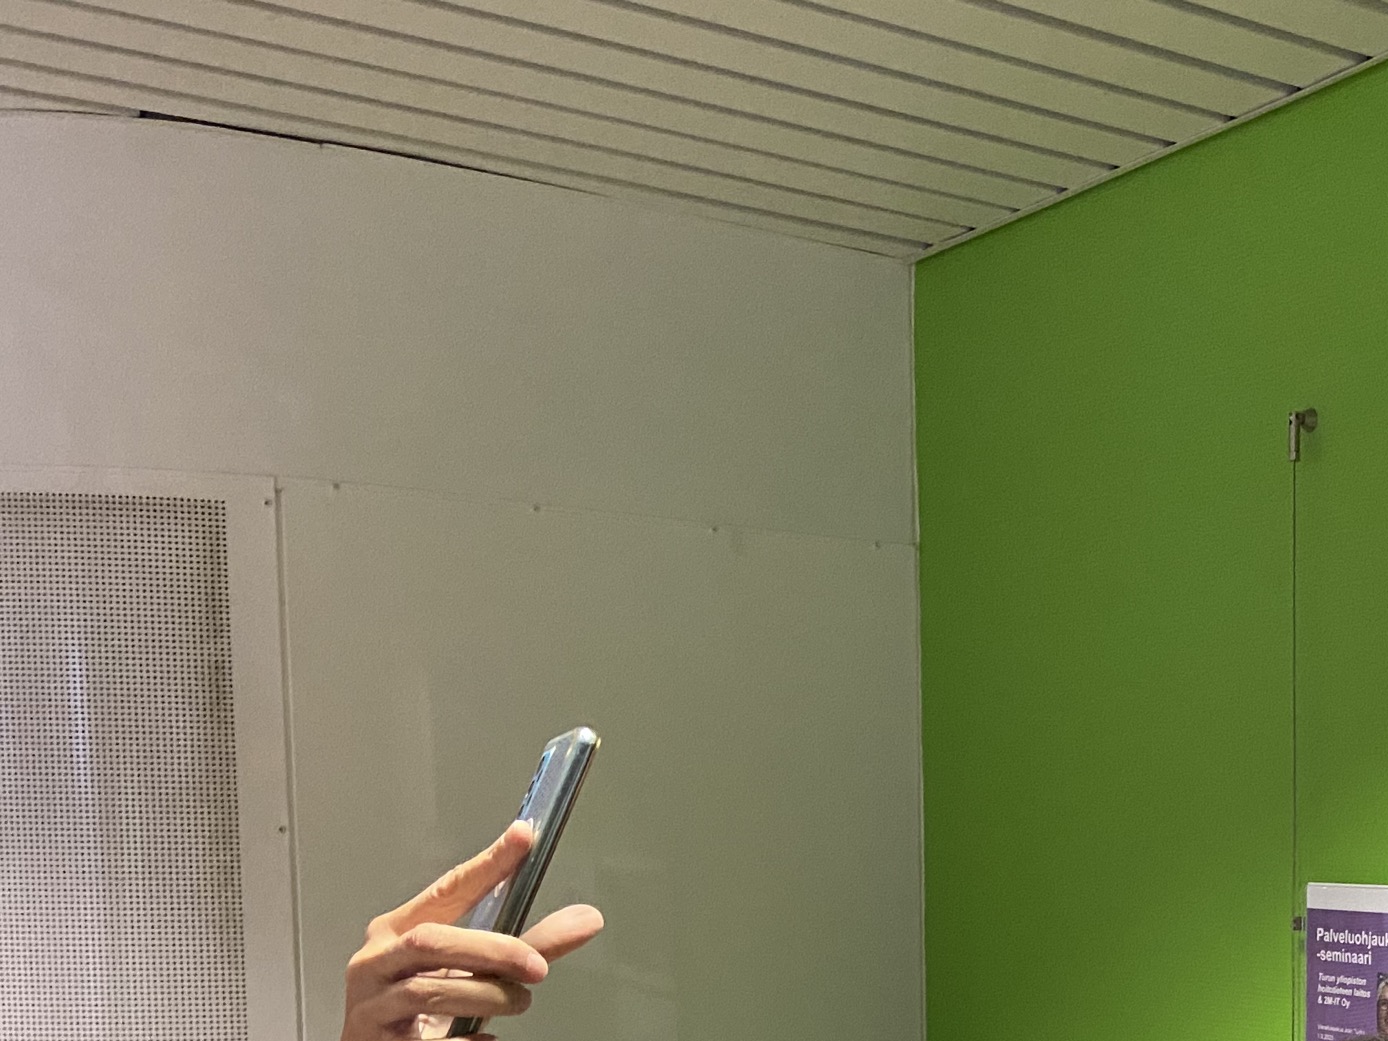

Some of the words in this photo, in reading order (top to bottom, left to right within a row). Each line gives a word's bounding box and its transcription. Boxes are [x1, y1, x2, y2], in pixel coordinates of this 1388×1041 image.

[1316, 949, 1372, 966] -seminaari
[1318, 972, 1335, 982] Turun
[1336, 975, 1367, 986] yliopiston
[1341, 997, 1351, 1009] Oy
